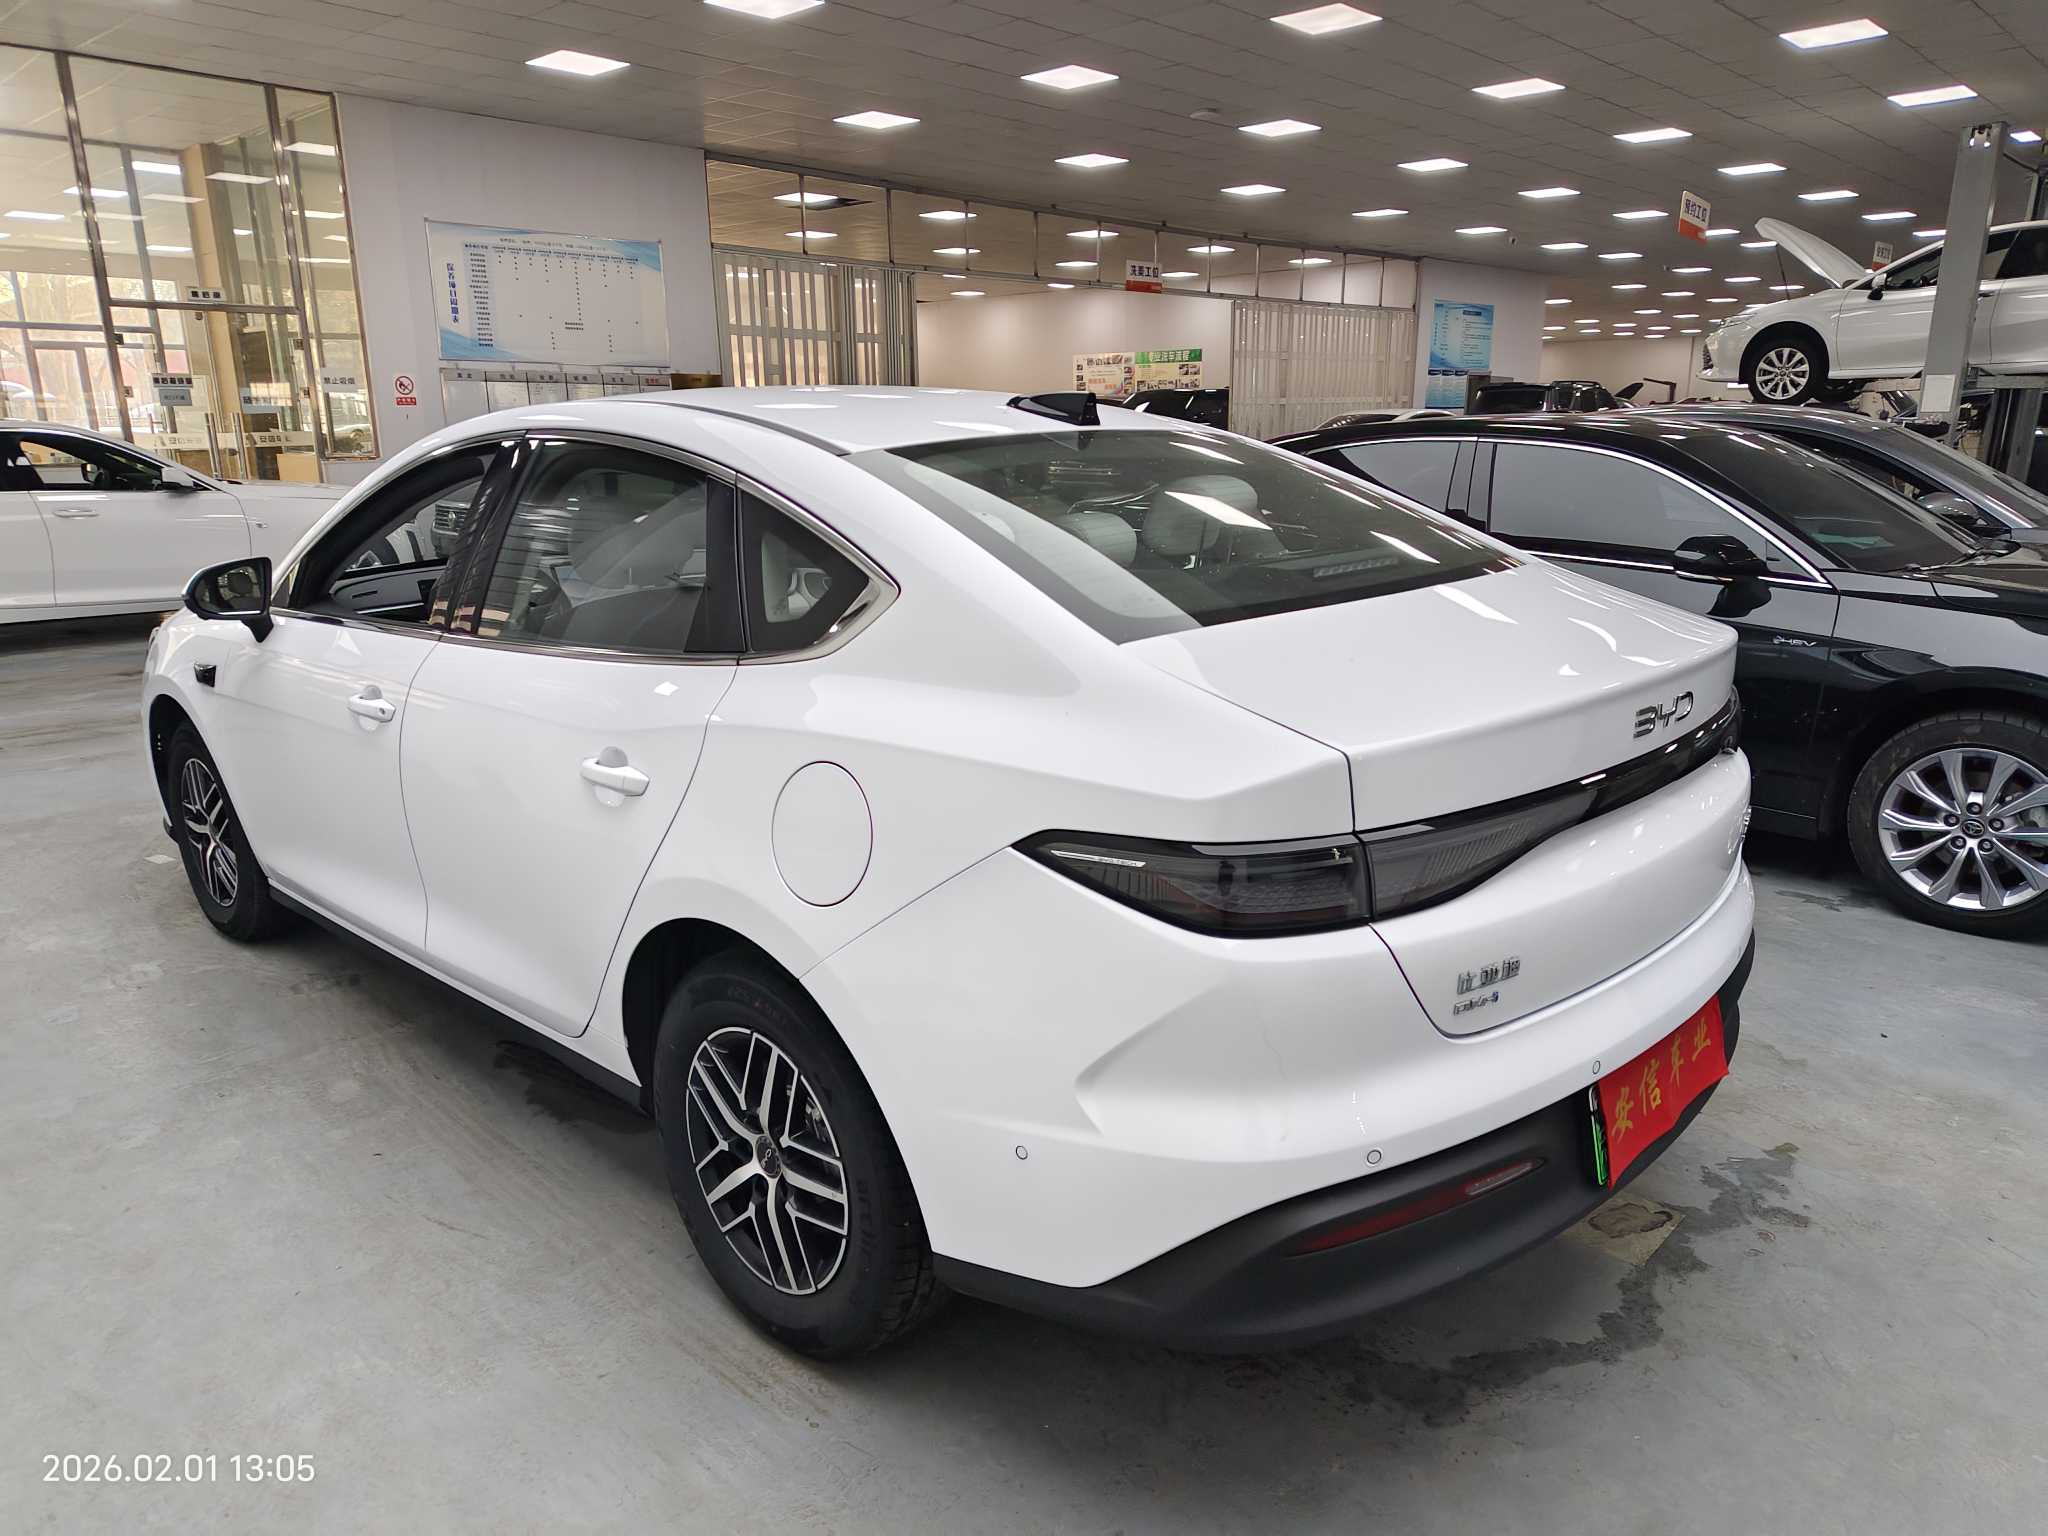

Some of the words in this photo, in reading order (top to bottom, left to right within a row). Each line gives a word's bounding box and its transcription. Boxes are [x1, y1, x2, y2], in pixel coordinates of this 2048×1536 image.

[1633, 690, 1694, 739] BYD
[1611, 1017, 1712, 1144] 安信车业
